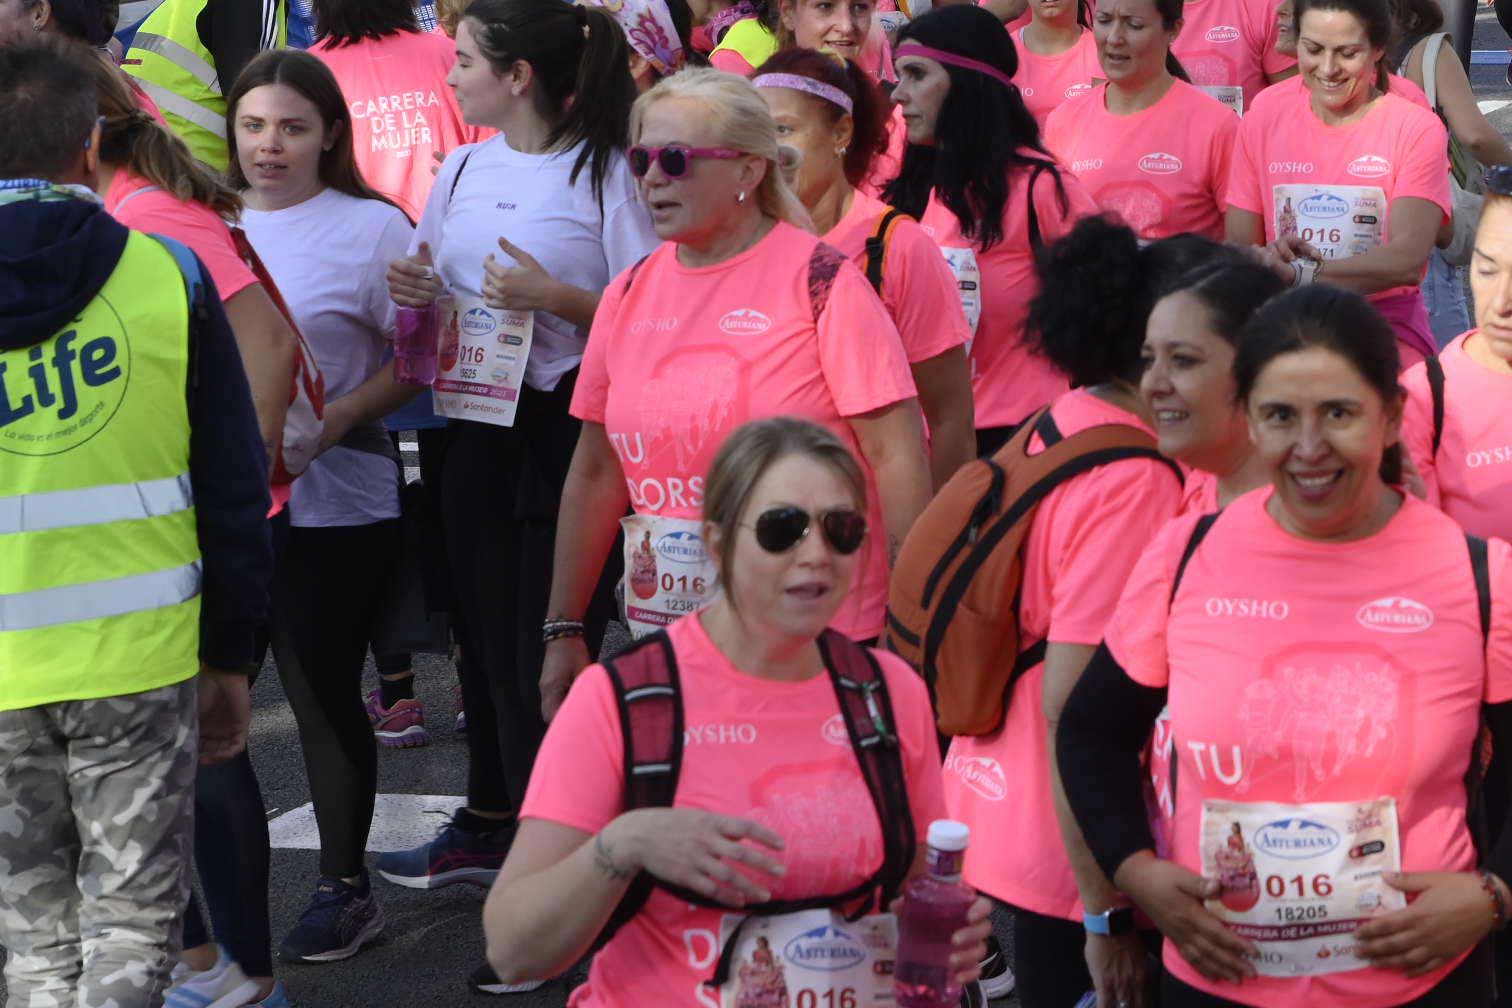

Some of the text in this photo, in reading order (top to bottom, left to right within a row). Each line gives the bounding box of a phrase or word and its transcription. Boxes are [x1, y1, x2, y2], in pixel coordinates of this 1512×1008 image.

[350, 90, 440, 119] CARRERA
[371, 110, 428, 134] DE LA
[371, 127, 433, 152] MUJER
[1267, 160, 1314, 175] OYSHO
[1301, 227, 1342, 243] 016
[0, 329, 122, 428] Life
[611, 431, 645, 463] TU
[627, 475, 705, 511] DORS
[661, 541, 705, 555] ASTURIA
[661, 572, 707, 593] 016
[1205, 596, 1289, 621] OYSHO
[1187, 740, 1244, 785] TU
[1262, 831, 1334, 849] ASTURIANA
[1265, 873, 1334, 898] 016
[1275, 904, 1329, 923] 18205
[1281, 926, 1298, 938] DE
[1299, 924, 1315, 937] LA
[793, 942, 864, 961] ASTURIANA
[796, 987, 858, 1008] 016
